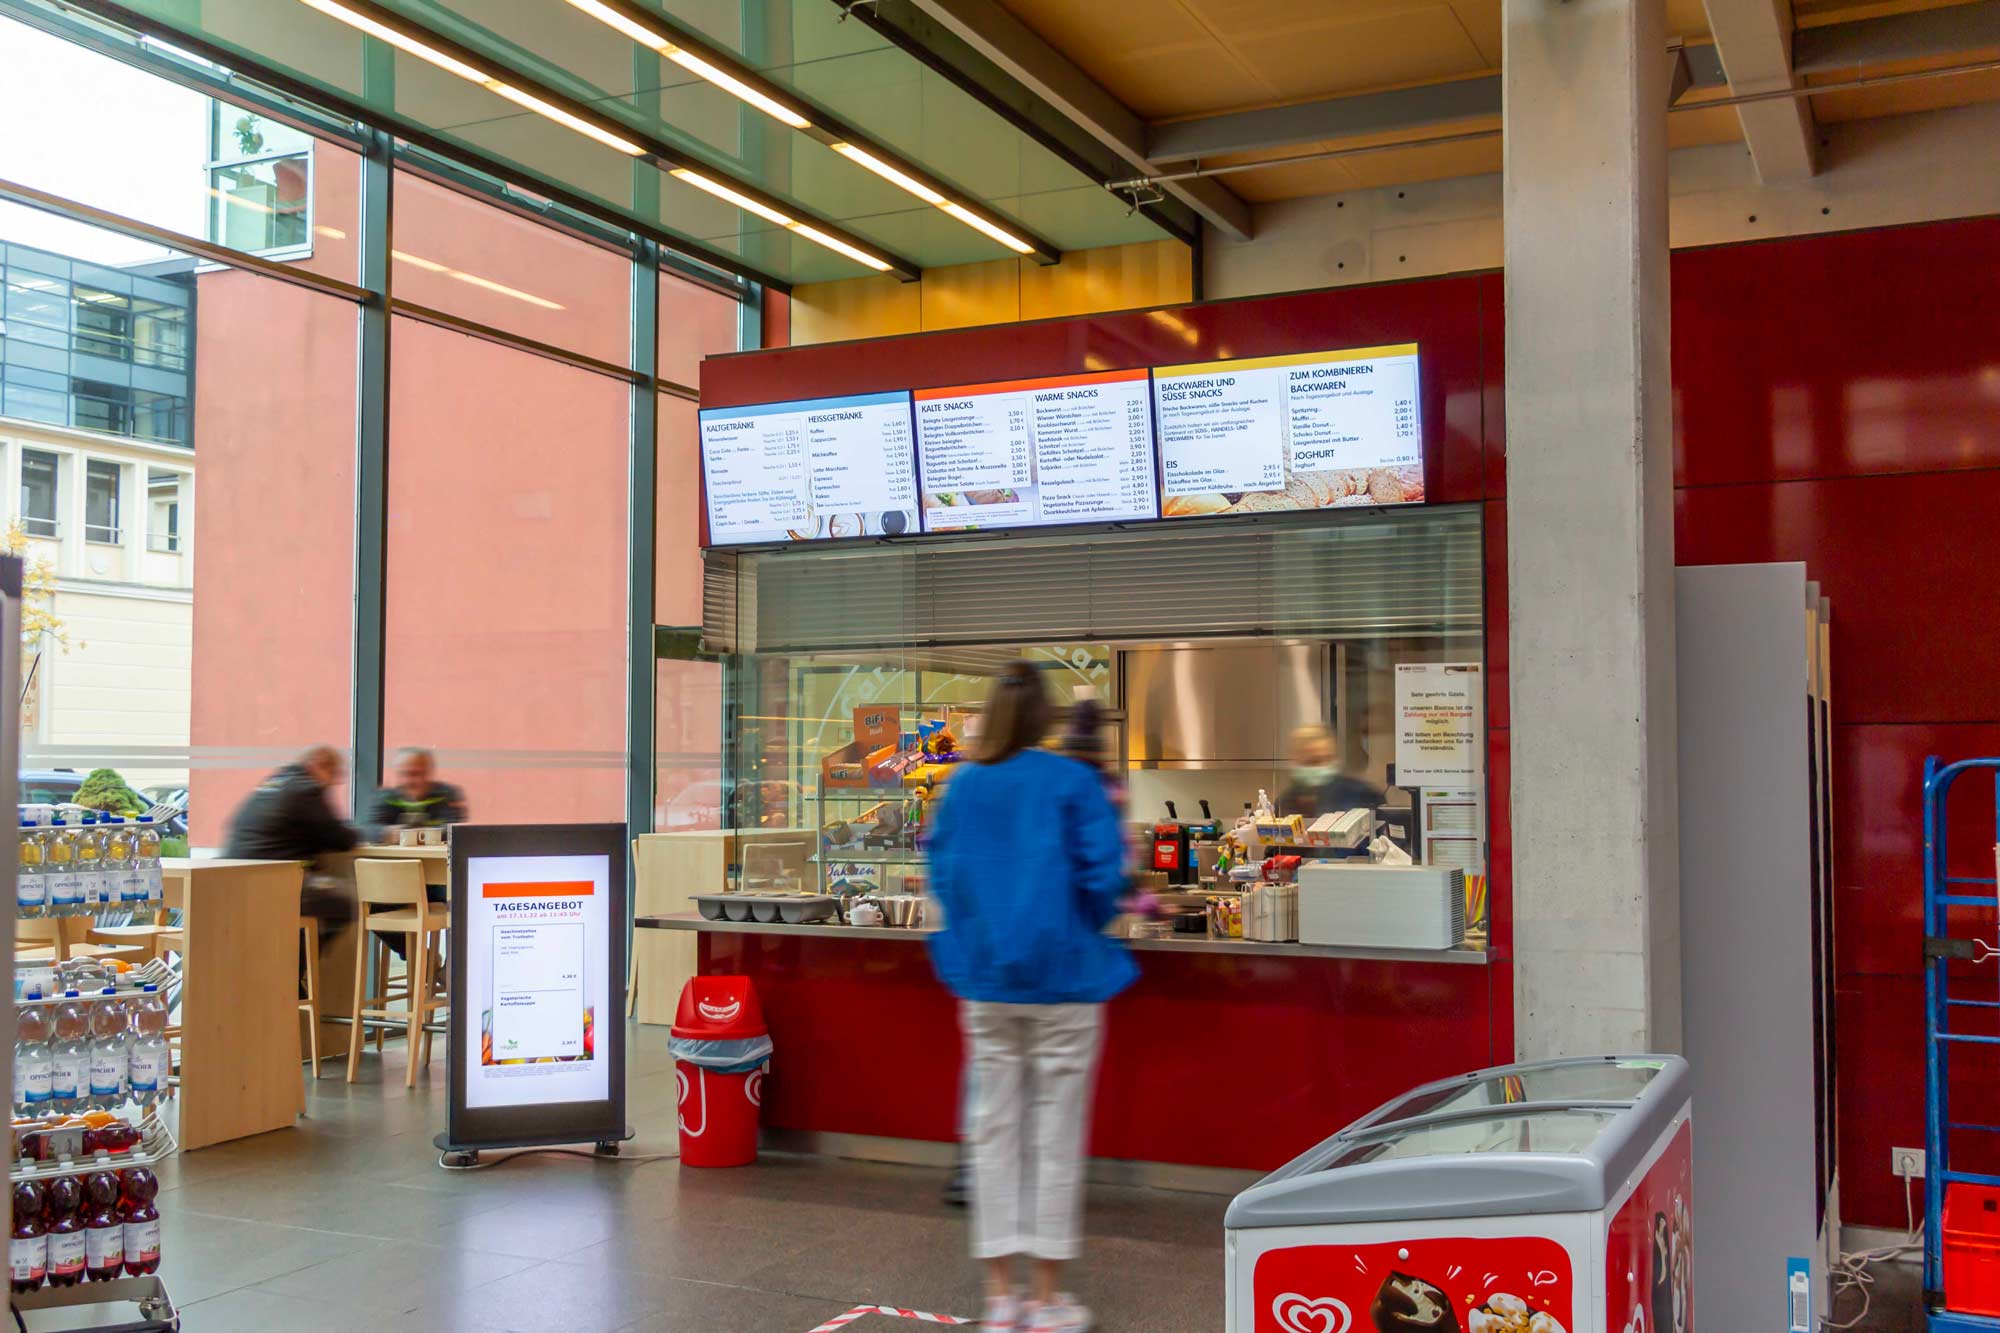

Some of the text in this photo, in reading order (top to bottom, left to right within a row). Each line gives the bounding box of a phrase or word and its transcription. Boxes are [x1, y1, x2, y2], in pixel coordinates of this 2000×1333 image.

[1290, 365, 1373, 380] ZUM KOMBINIEREN
[1162, 378, 1235, 391] BACKWAREN UND
[1291, 381, 1346, 393] BACKWAREN
[1035, 390, 1098, 402] WARME SNACKS
[1162, 389, 1223, 401] SÜSSE SNACKS
[922, 401, 974, 413] KALTE SNACKS
[809, 411, 862, 423] HEISSGETRÄNKE
[707, 420, 754, 432] KALTGETRÄNKE
[1295, 450, 1334, 460] JOGHURT
[493, 901, 583, 911] TAGESANGEBOT
